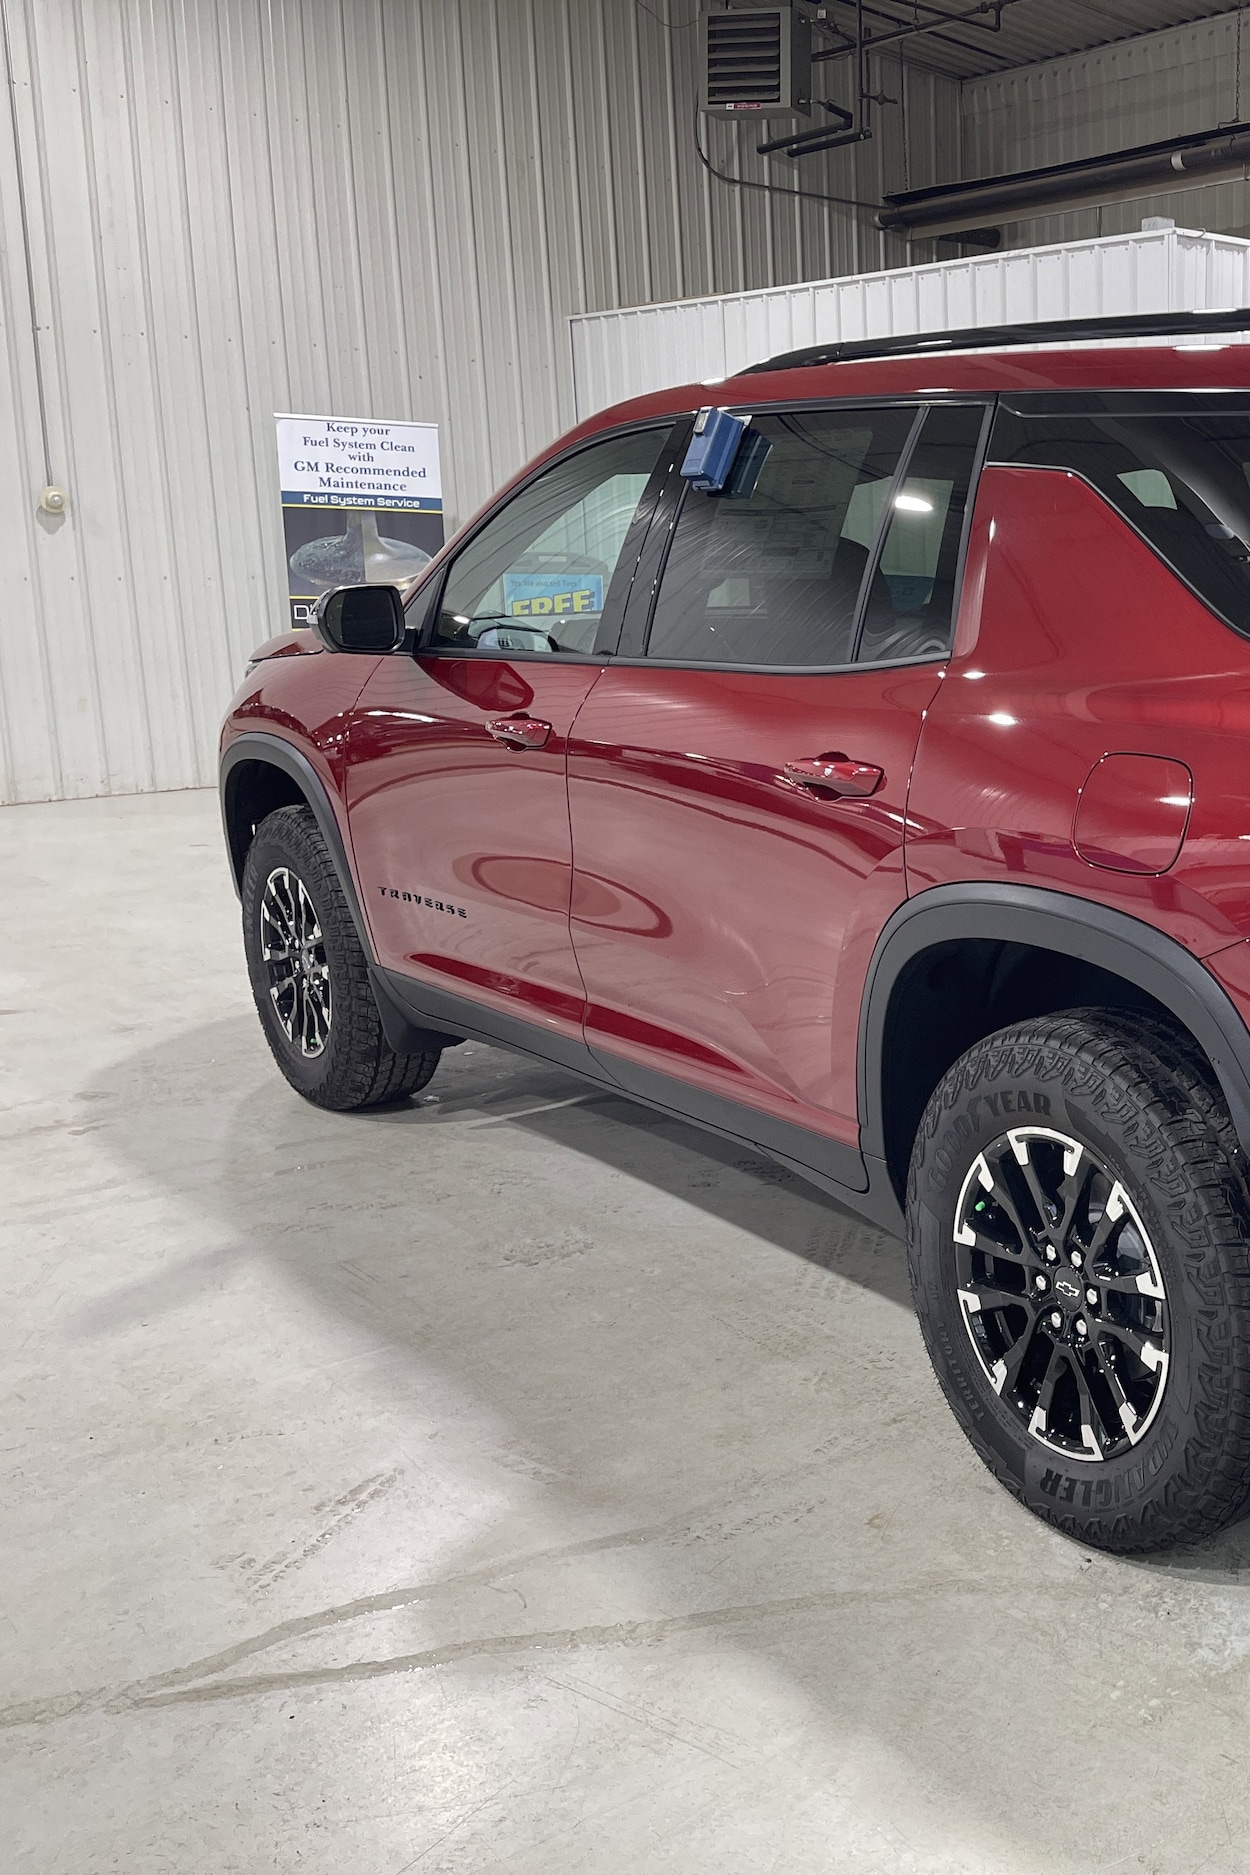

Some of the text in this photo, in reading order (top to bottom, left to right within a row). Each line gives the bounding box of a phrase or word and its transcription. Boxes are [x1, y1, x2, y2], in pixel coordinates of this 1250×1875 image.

[326, 422, 390, 437] Keep your
[303, 436, 415, 452] Fuel System Clean
[348, 453, 374, 462] with
[294, 461, 426, 478] GM Recommended
[319, 477, 407, 491] Maintenance
[303, 494, 420, 508] Fuel System Service
[512, 589, 591, 616] FREE
[378, 887, 467, 918] TRAVERSE
[1039, 1416, 1178, 1508] WRANGLER
